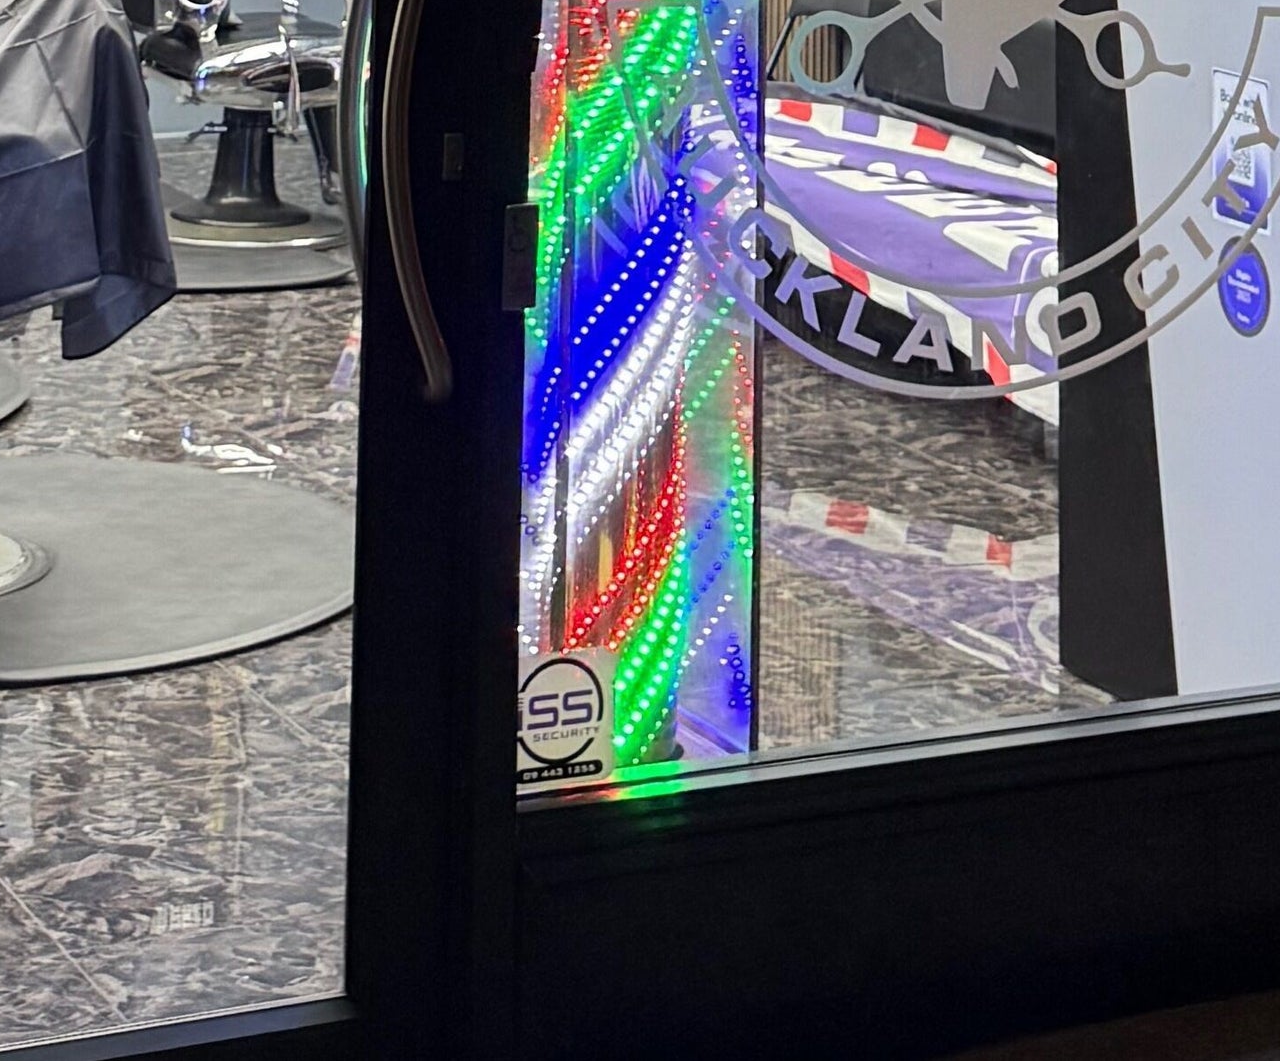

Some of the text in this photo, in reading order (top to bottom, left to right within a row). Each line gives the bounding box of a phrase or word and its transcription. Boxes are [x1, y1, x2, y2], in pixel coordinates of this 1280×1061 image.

[1123, 93, 1280, 312] CITY
[533, 726, 600, 742] SECURITY
[523, 771, 538, 781] 09
